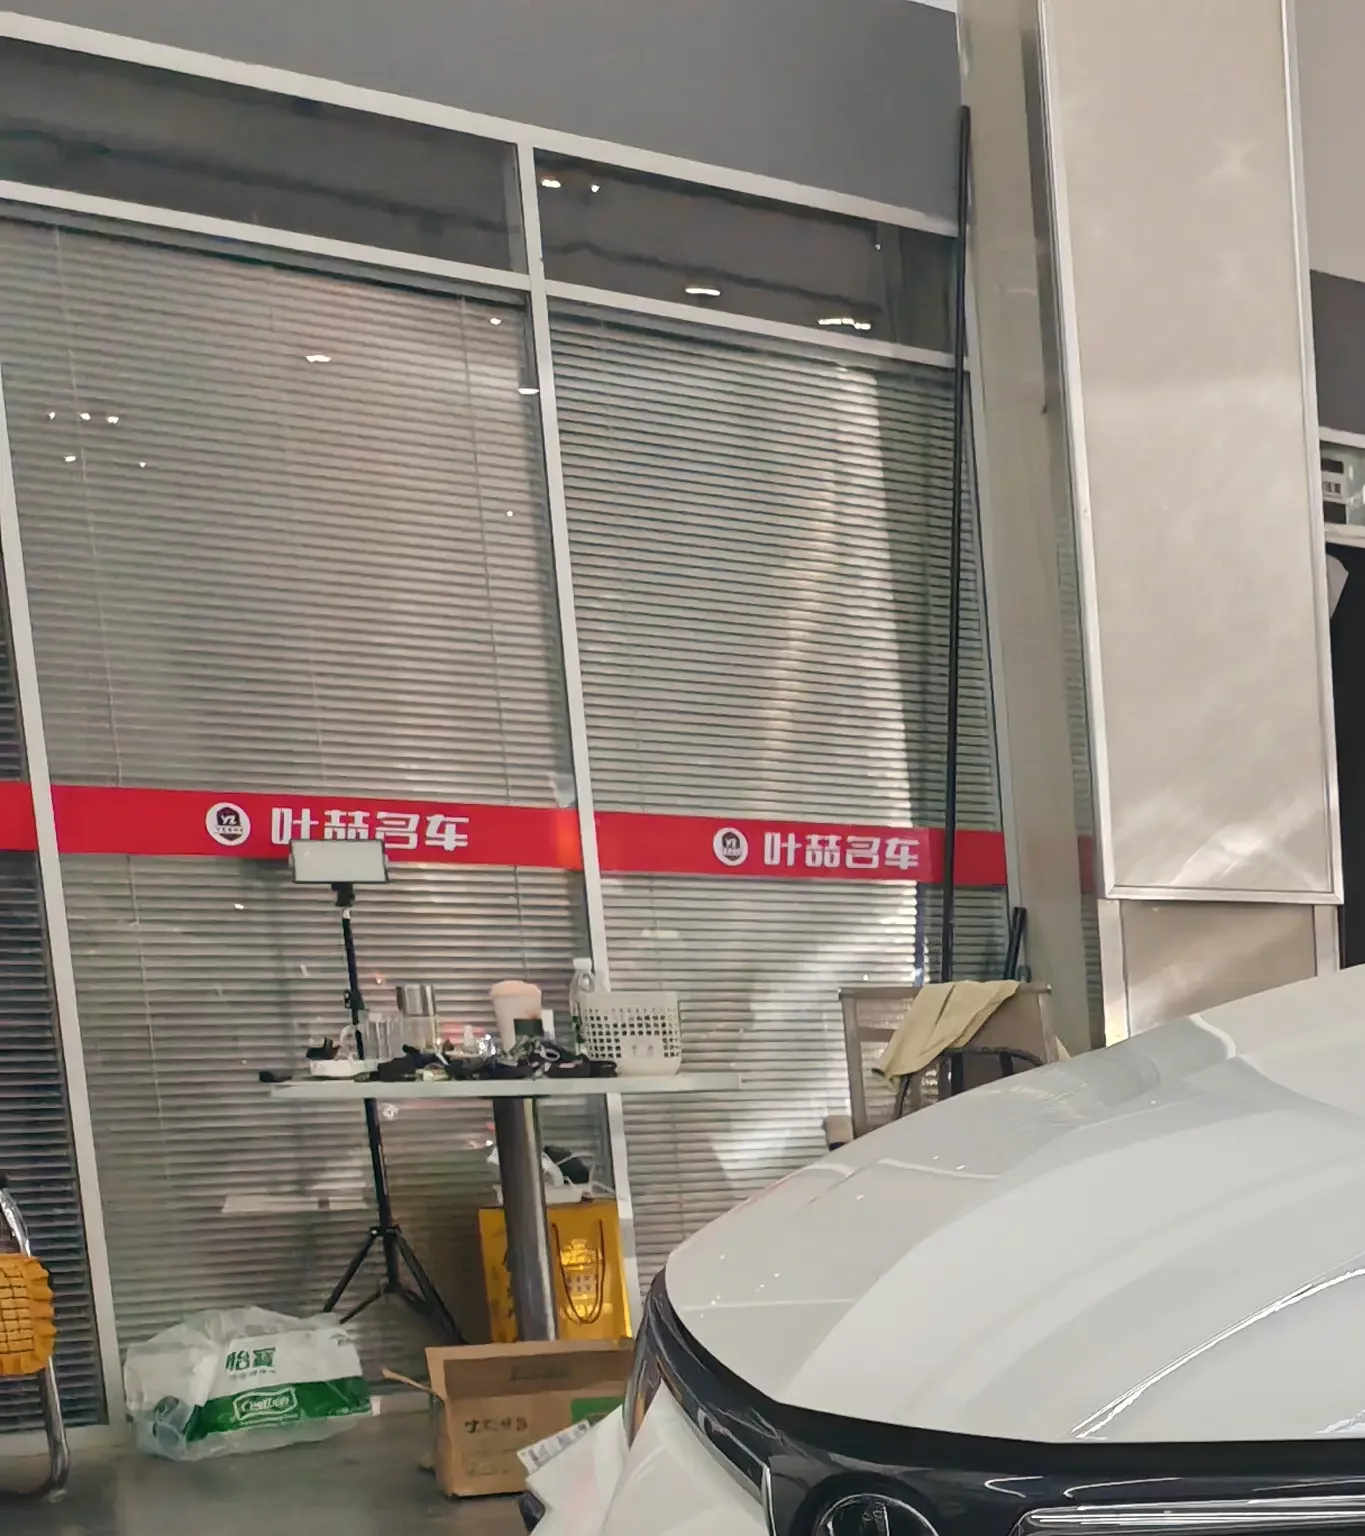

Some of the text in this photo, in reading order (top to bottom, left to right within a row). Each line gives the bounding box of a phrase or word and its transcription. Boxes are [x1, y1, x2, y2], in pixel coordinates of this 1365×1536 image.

[271, 807, 470, 852] 叶喆名车
[763, 831, 920, 870] 叶喆名车
